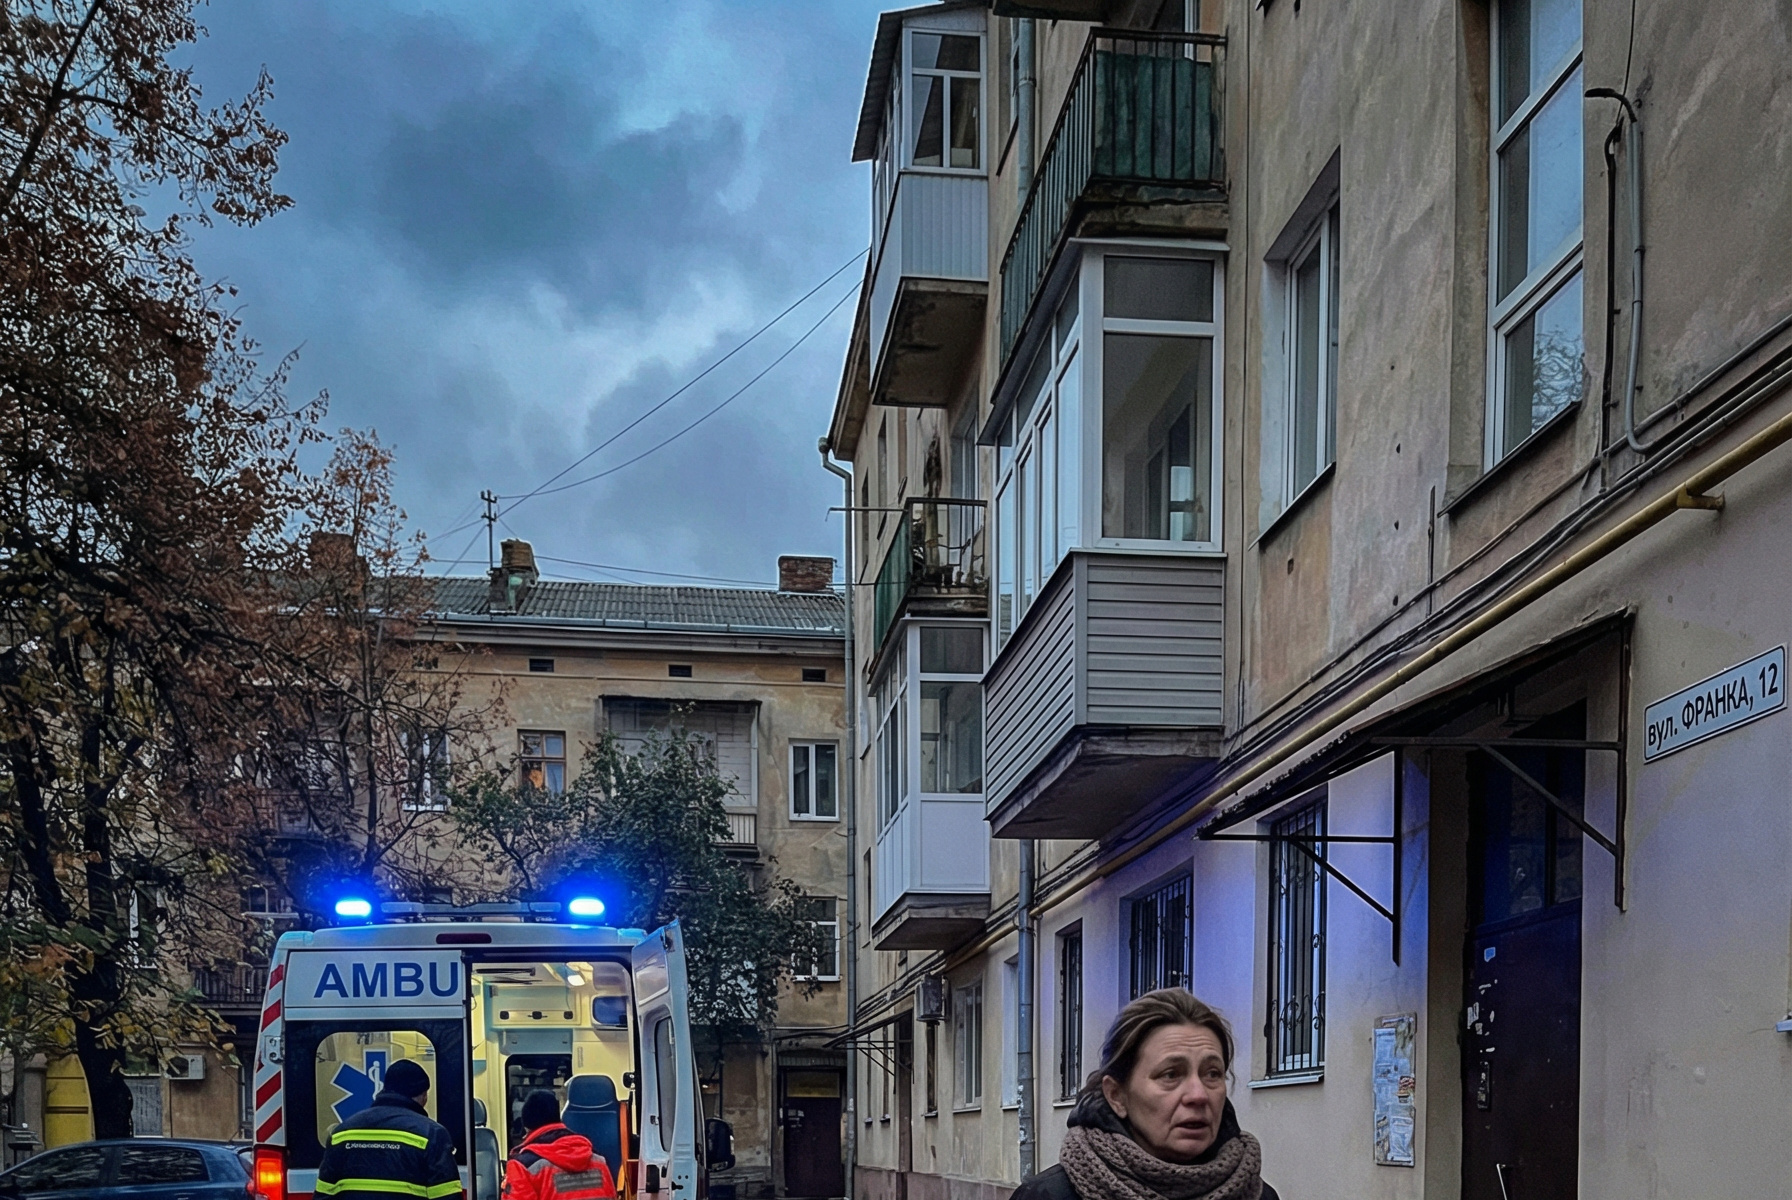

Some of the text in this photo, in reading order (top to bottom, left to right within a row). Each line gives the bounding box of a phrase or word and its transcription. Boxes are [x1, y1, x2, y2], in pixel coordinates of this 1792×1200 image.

[1648, 662, 1779, 751] вул. ФРАНКА, 12
[313, 962, 459, 998] AMBU
